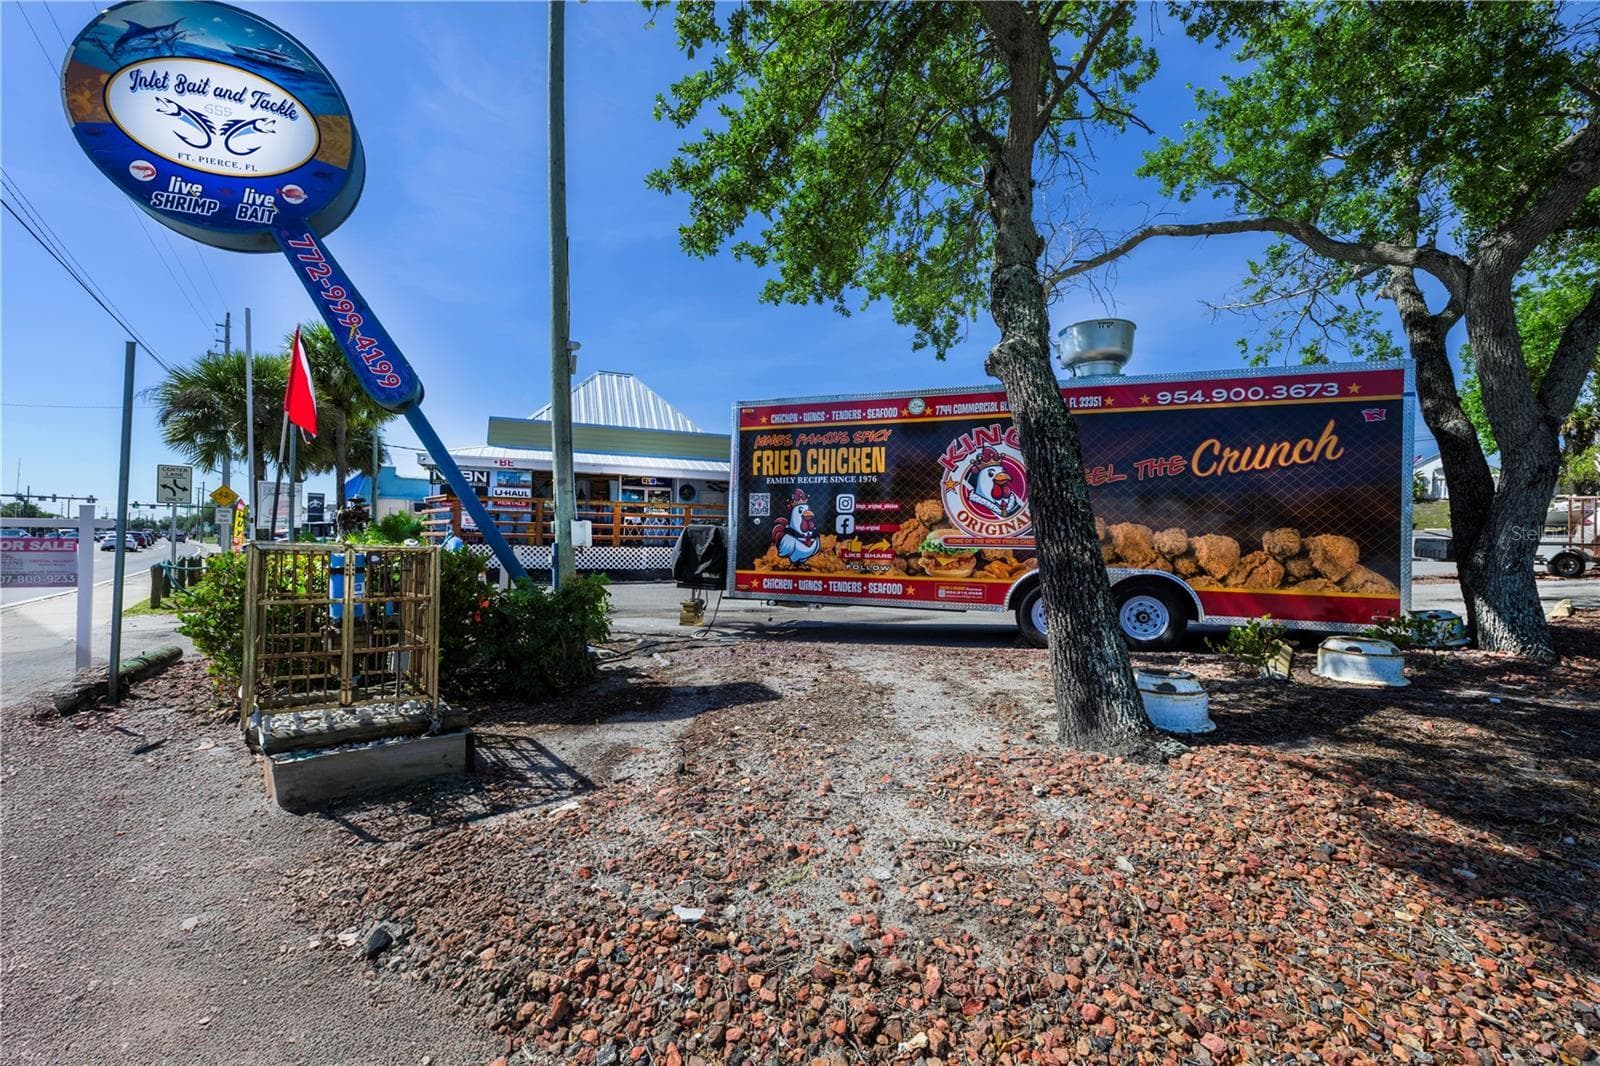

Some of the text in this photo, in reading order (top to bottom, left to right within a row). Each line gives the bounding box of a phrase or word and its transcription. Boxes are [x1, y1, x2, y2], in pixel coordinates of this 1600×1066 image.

[129, 68, 300, 122] Inlet Bait and Tackle
[177, 152, 195, 163] FT.
[168, 176, 202, 197] live
[151, 191, 219, 216] SHRIMP
[243, 188, 275, 207] live
[236, 203, 277, 224] BAIT
[1069, 397, 1078, 408] FL
[1079, 396, 1102, 407] 33351
[1157, 383, 1339, 404] 954.900.3673
[771, 413, 798, 424] CHICKEN
[803, 411, 826, 422] WINGS
[832, 409, 862, 420] TENDERS
[867, 407, 898, 419] SEAFOOD
[935, 405, 952, 416] 7744
[796, 432, 850, 447] FAMOUS
[853, 429, 892, 444] SPICY
[1191, 419, 1344, 478] Crunch
[752, 446, 886, 476] FRIED CHICKEN
[1133, 455, 1188, 480] THE
[766, 475, 878, 485] FAMILY RECIPE SINCE 1976
[494, 489, 529, 497] U-HAUL
[29, 541, 75, 551] SALE
[763, 578, 903, 595] CHICKEN WINGS TENDERS SEAFOOD
